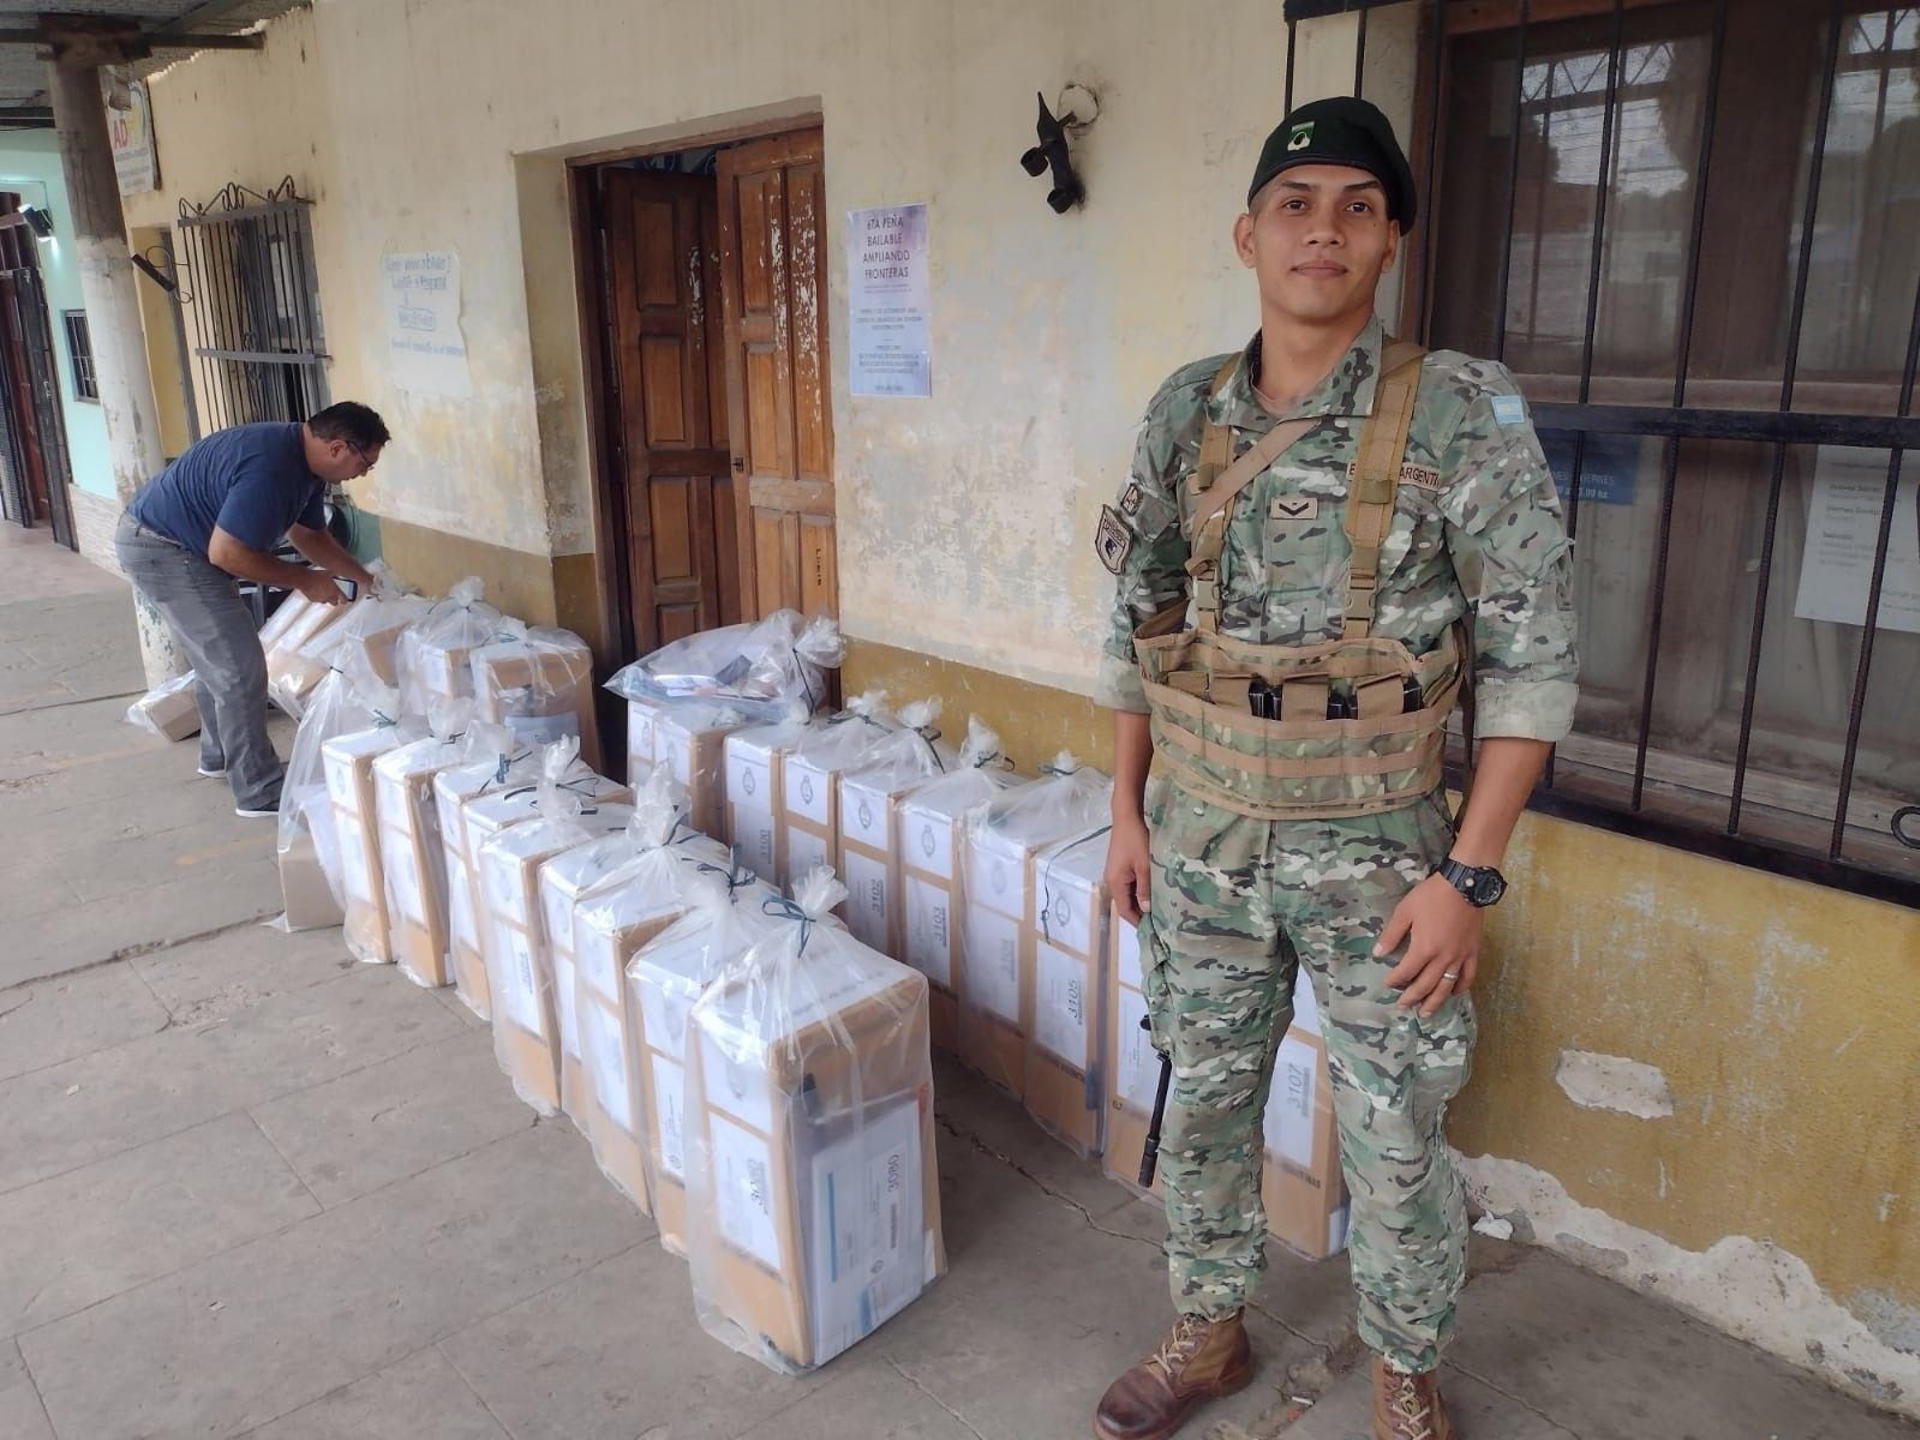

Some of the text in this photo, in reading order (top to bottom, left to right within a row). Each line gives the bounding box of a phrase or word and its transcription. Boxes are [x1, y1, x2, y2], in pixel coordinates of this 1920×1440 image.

[882, 213, 904, 229] PEÑA
[867, 232, 903, 247] BAILABLE
[863, 250, 910, 263] AMPLIANDO
[864, 266, 909, 280] FRONTERAS
[1068, 979, 1079, 1019] 3105
[1287, 1063, 1304, 1109] 3107
